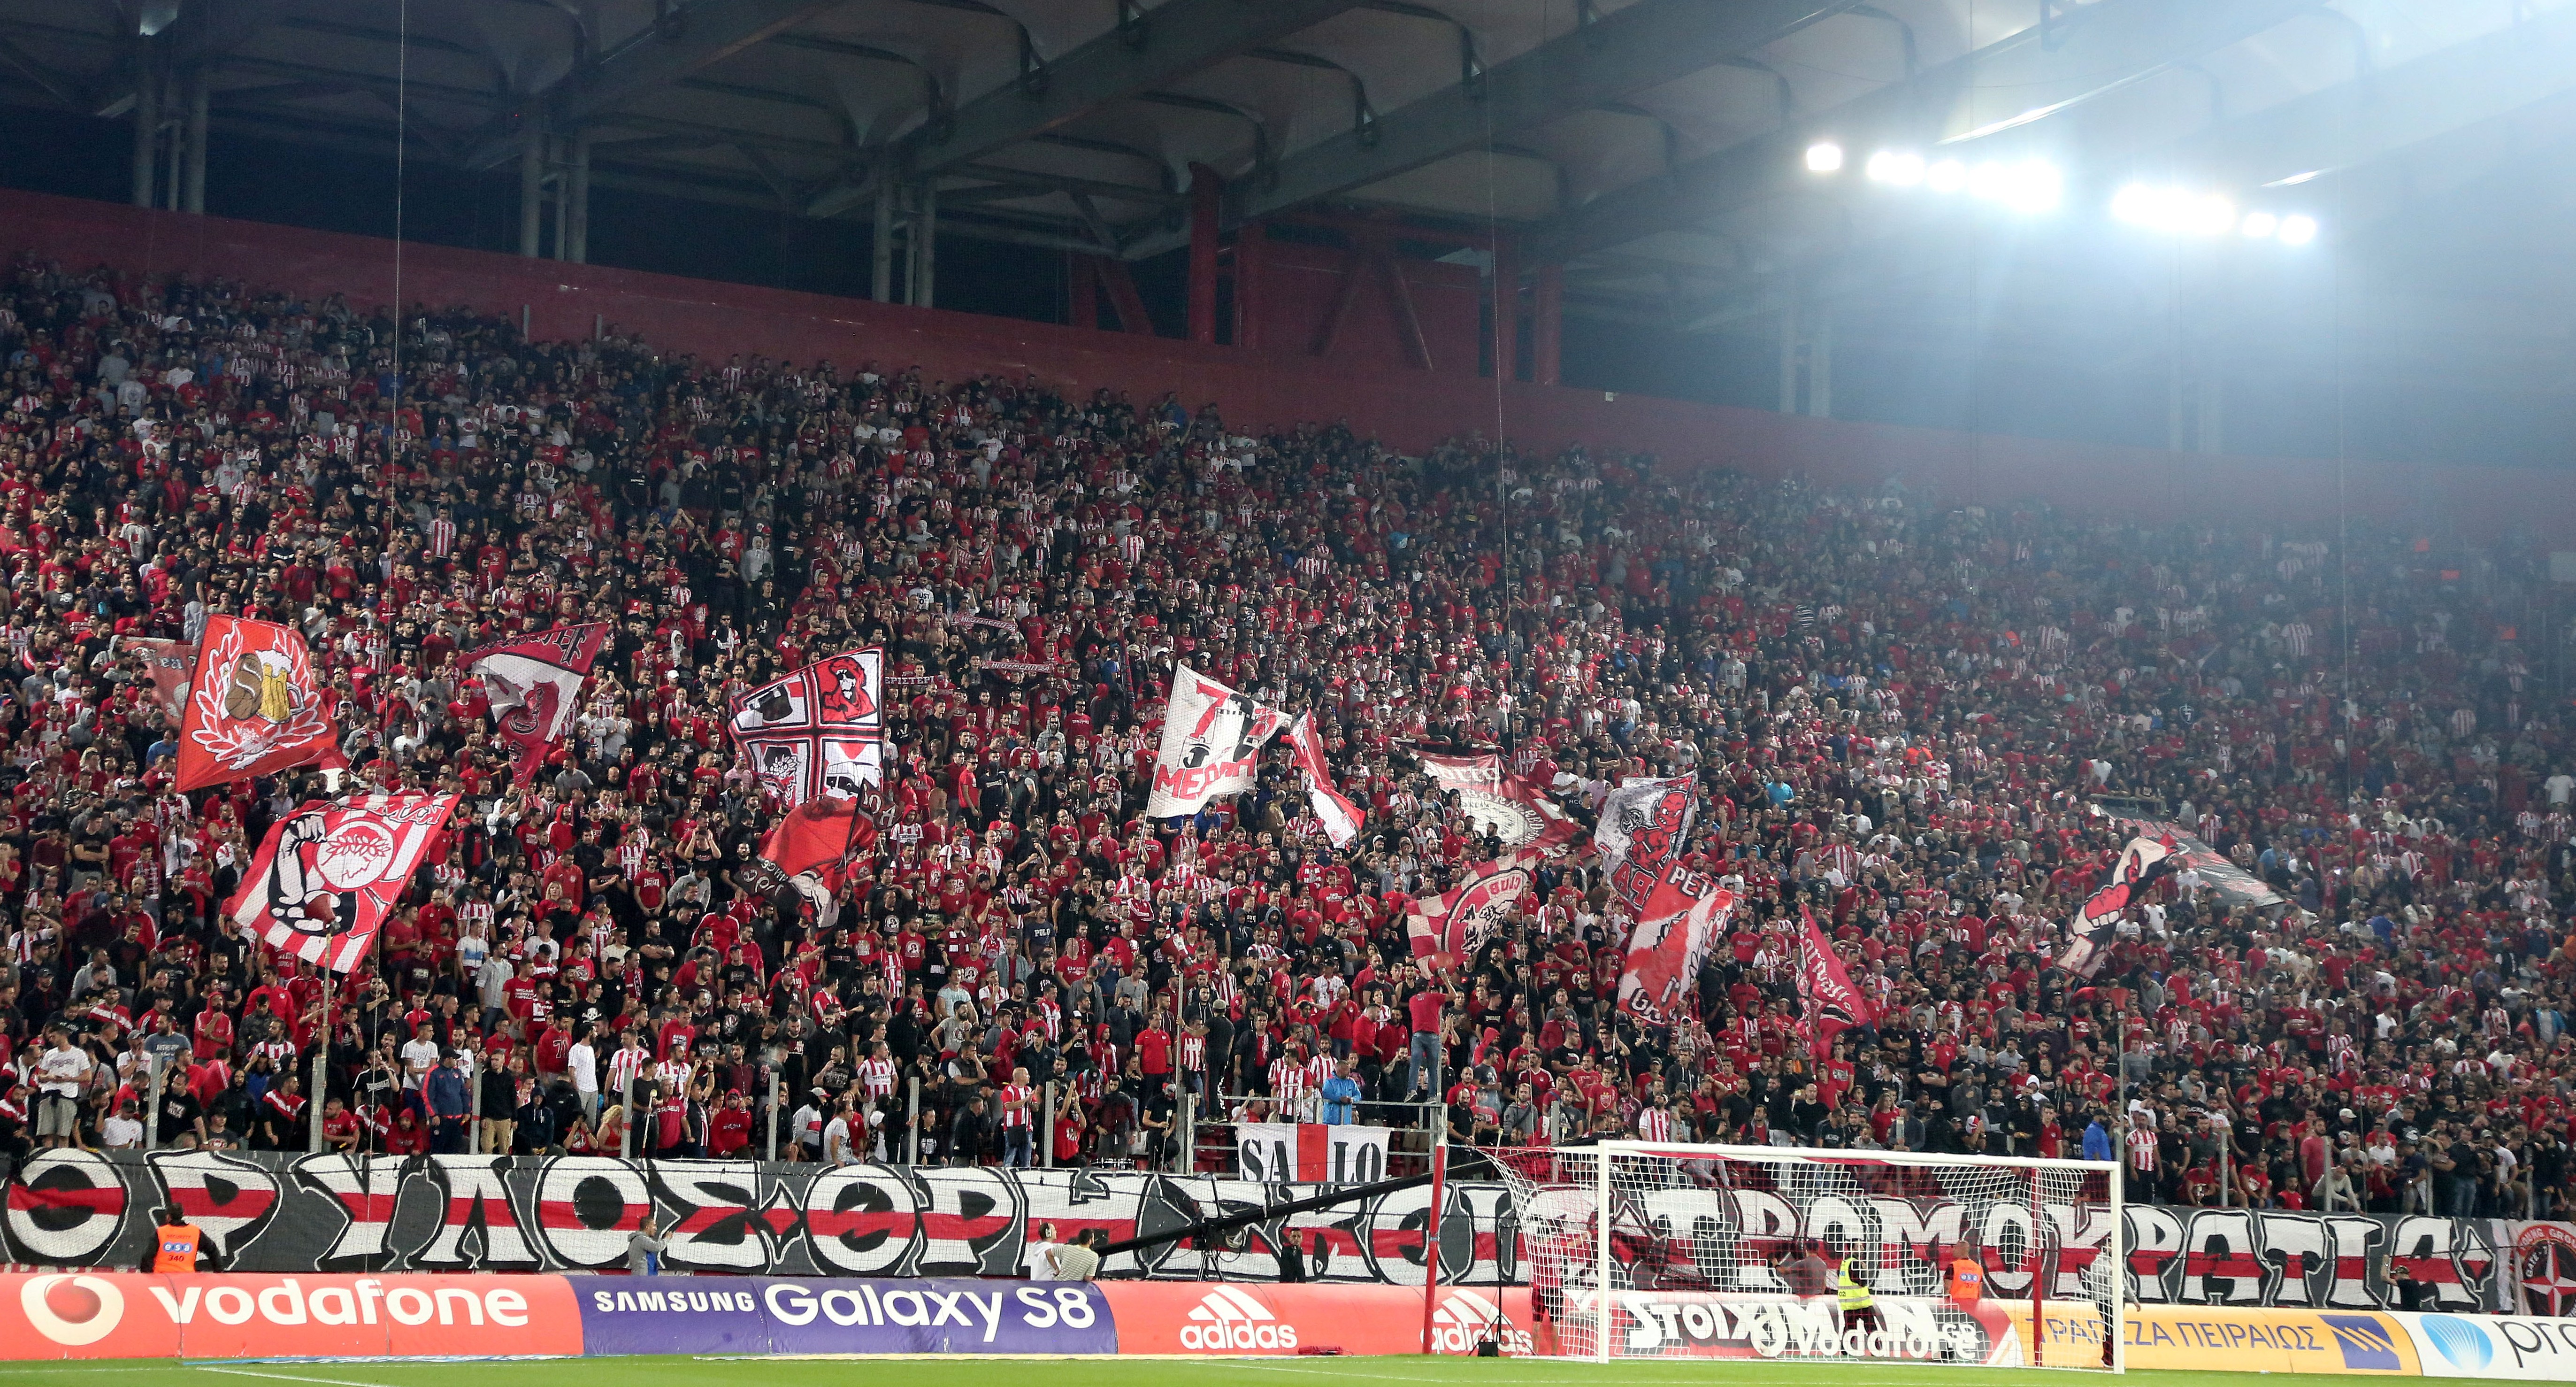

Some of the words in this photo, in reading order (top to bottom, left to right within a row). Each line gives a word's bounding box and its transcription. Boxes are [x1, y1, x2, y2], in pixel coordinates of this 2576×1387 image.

[885, 675, 935, 685] ΕΡΙΣΤΕΡΙ
[148, 1278, 529, 1326] vodafone
[593, 1289, 754, 1313] SAMSUNG
[763, 1284, 1003, 1343] Galaxy
[1014, 1287, 1096, 1330] S8
[1179, 1319, 1298, 1350] adidas
[2025, 1318, 2176, 1347] ΤΡΑΠΖΑ
[2176, 1322, 2324, 1352] ΠΕΙΡΑΙΩΣ
